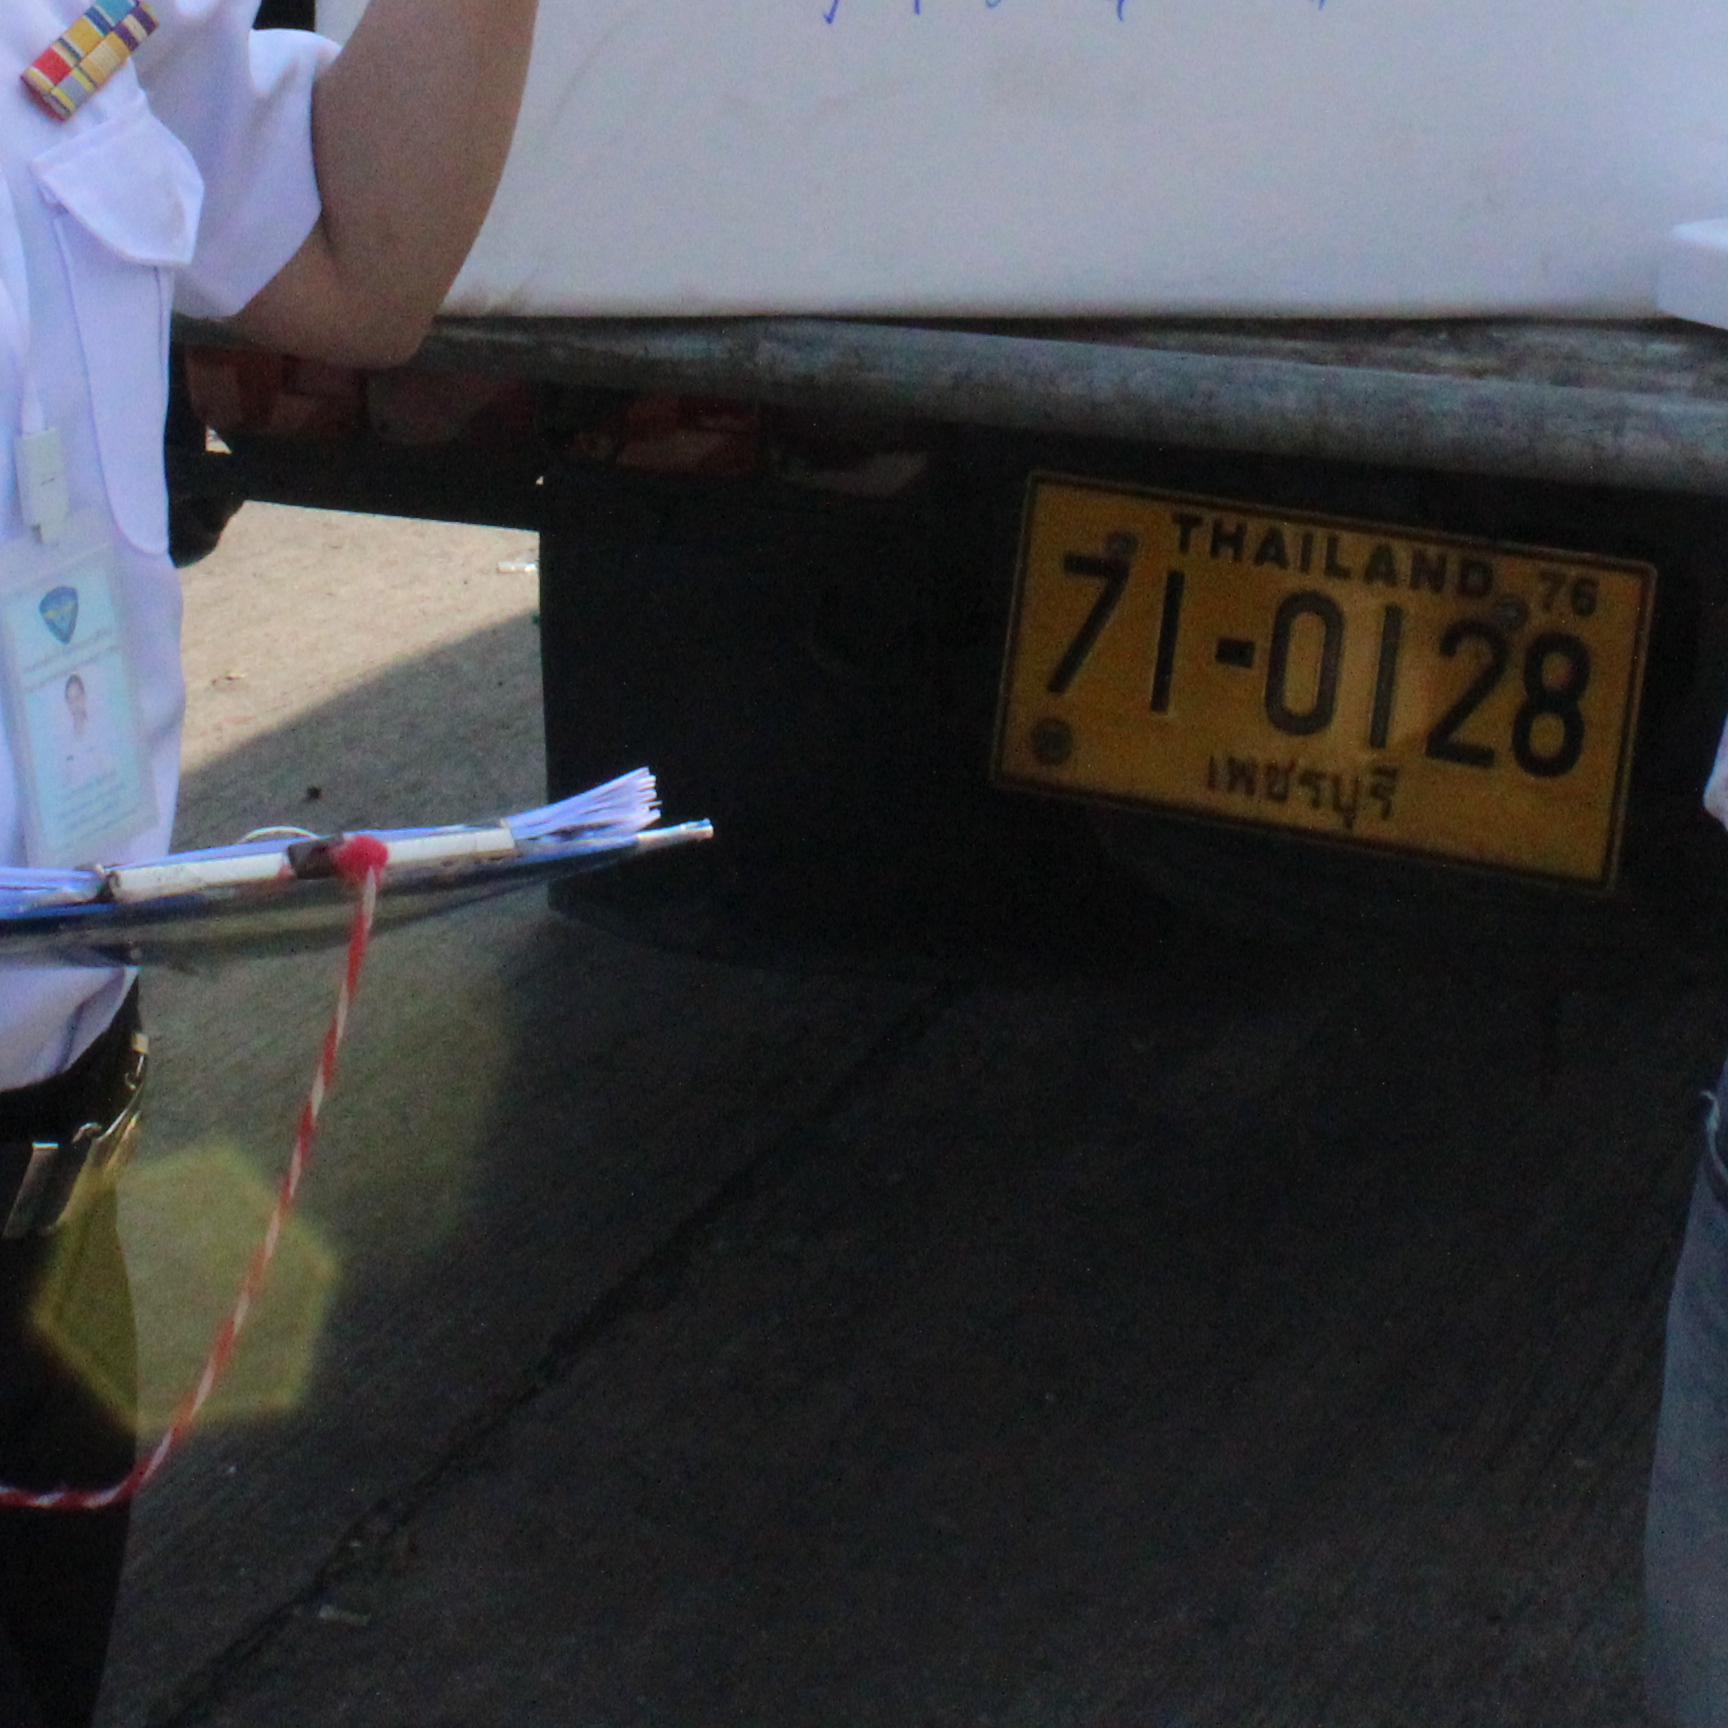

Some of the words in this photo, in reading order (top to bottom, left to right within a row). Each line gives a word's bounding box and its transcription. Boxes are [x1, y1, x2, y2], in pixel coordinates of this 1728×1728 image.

[1173, 512, 1497, 599] THAILAND
[1538, 572, 1599, 618] 76
[1047, 552, 1593, 778] 71-0128
[1207, 753, 1399, 830] เพชรบุรี
